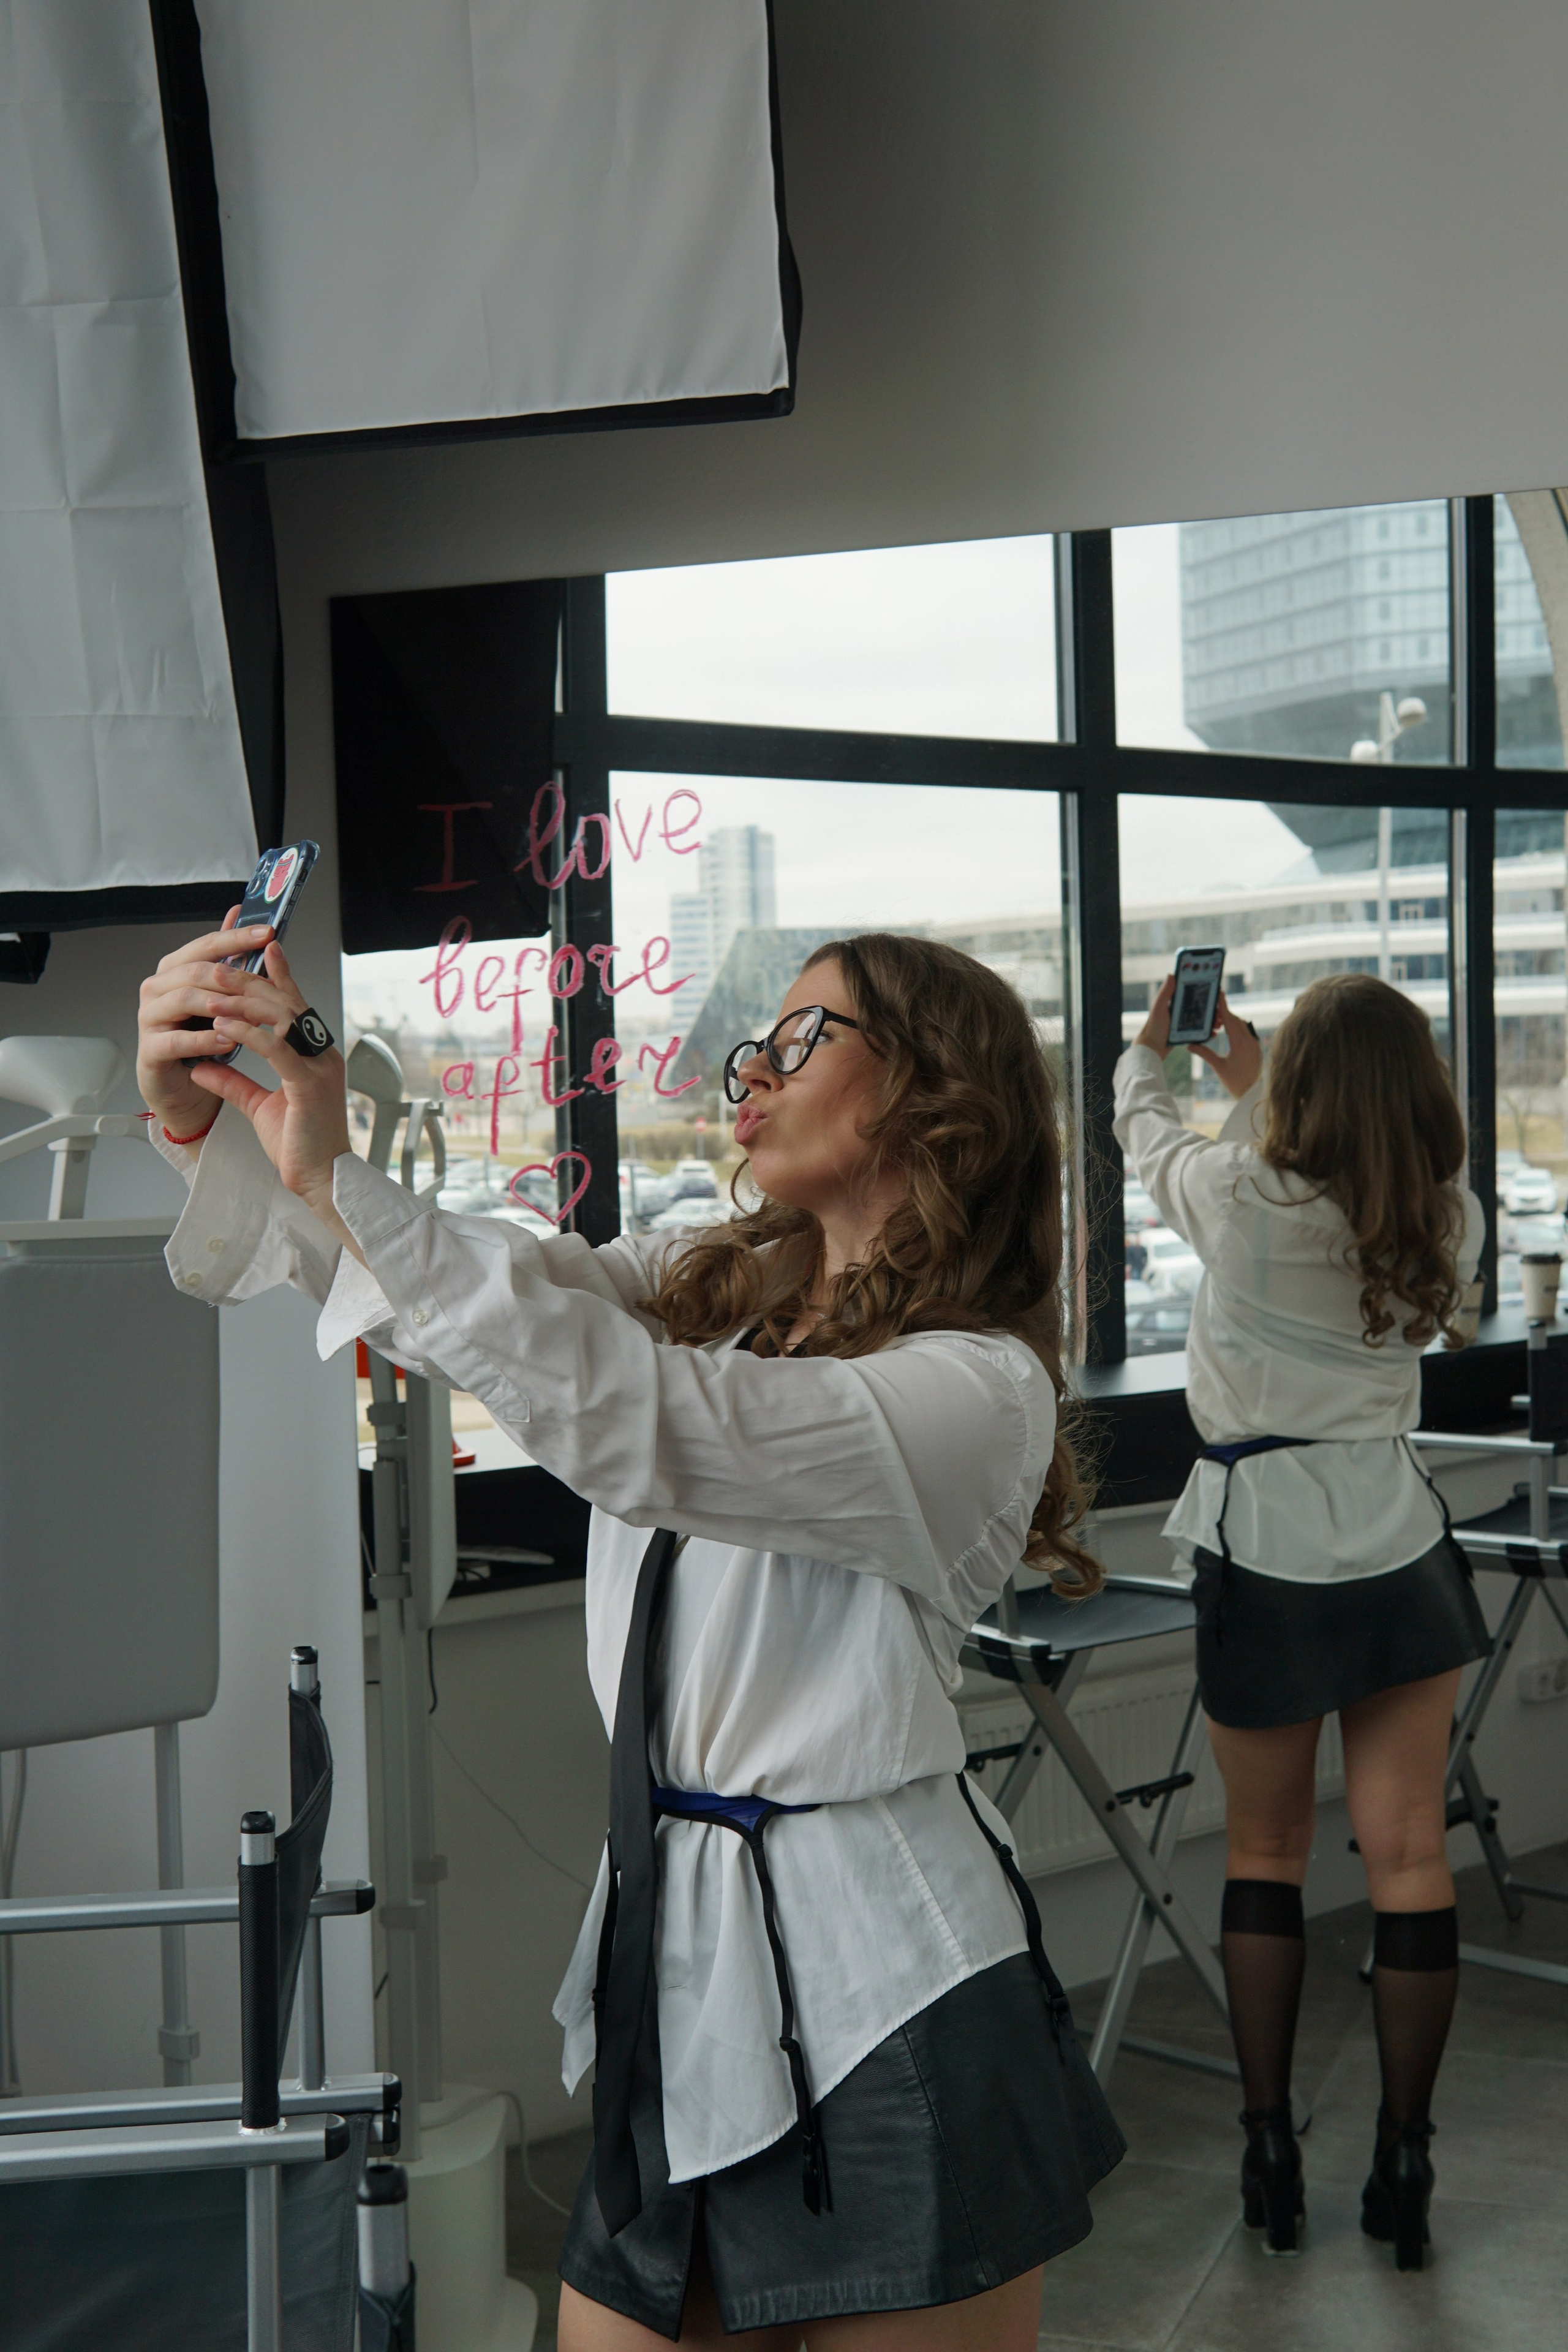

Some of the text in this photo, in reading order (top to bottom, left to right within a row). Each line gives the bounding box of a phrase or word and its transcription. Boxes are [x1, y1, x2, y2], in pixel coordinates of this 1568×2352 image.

[413, 780, 703, 892] I love
[419, 915, 697, 1056] before
[440, 1025, 702, 1156] after
